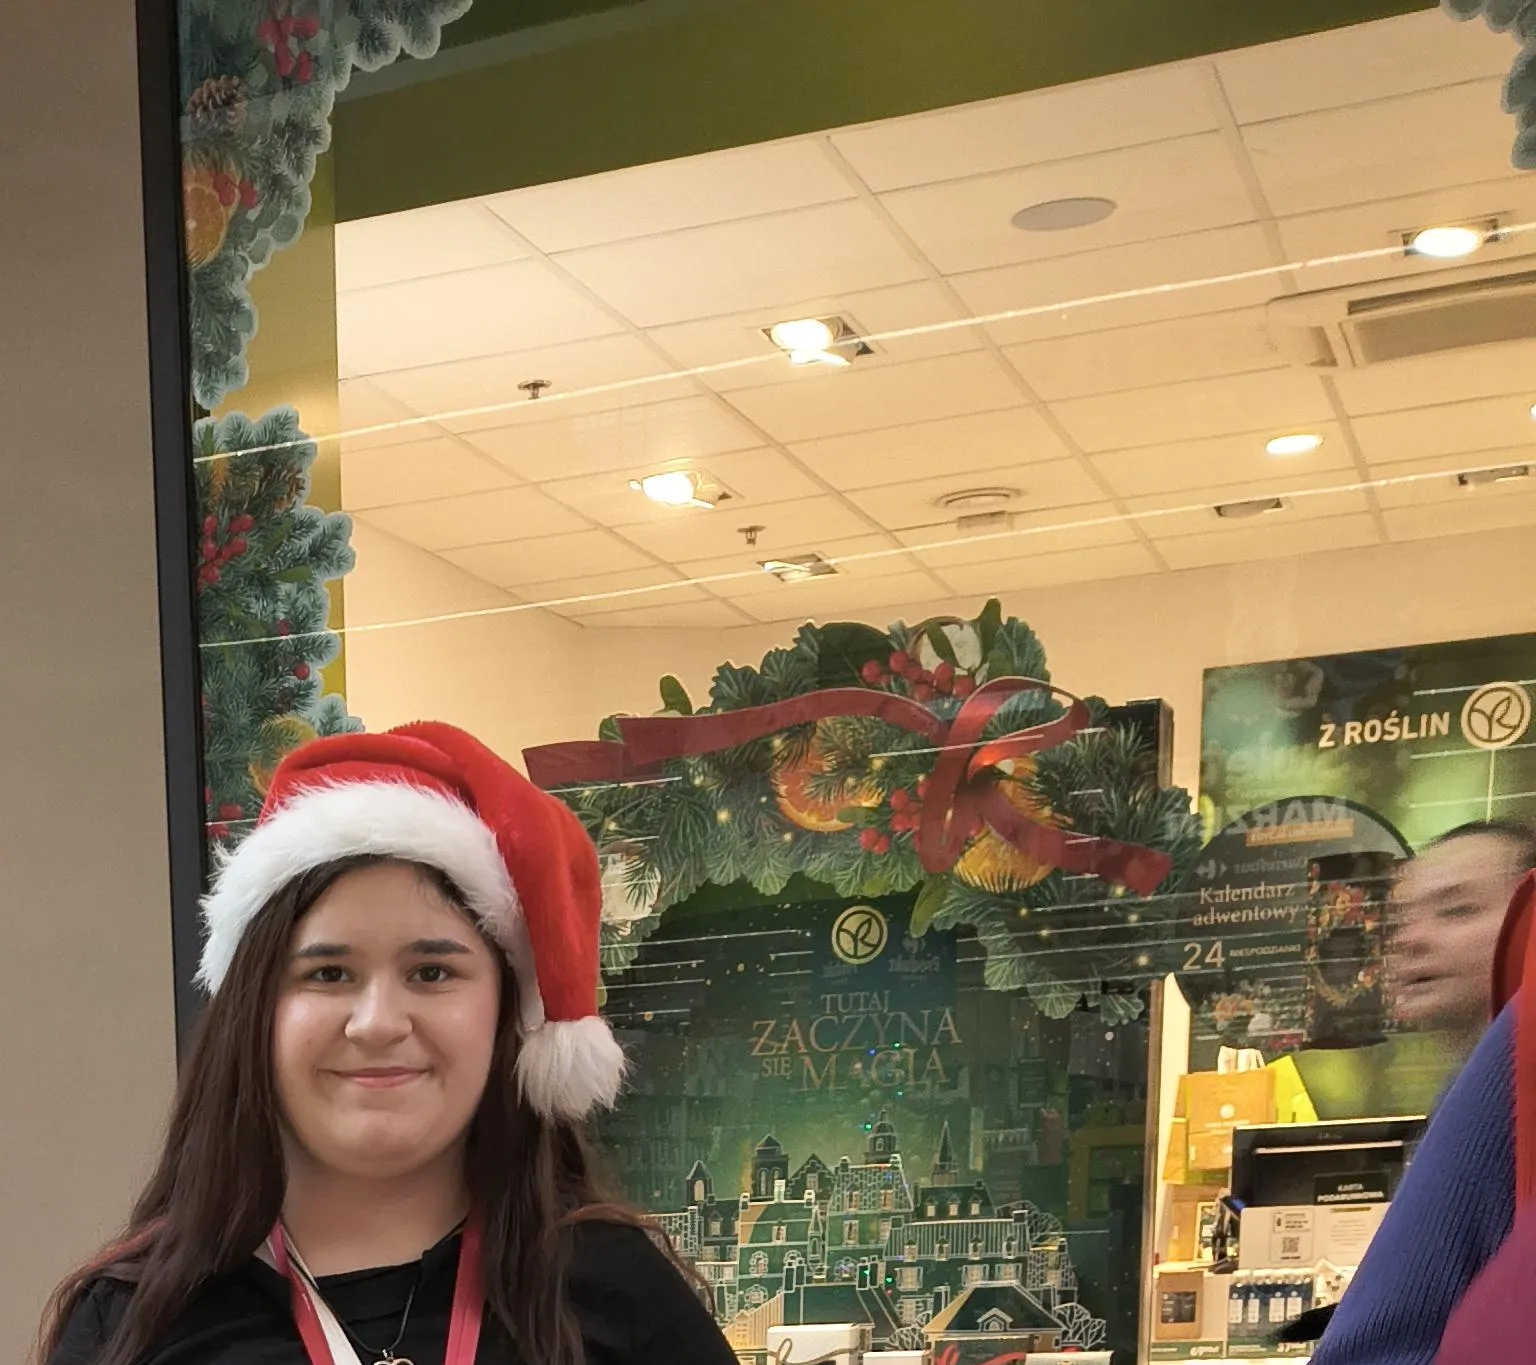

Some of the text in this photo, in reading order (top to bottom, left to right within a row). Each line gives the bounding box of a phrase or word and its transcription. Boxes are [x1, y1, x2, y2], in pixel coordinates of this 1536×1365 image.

[1318, 709, 1450, 749] Z ROŚLIN
[1199, 882, 1295, 905] Kalendarz
[1193, 904, 1299, 927] adwentowy
[1183, 940, 1225, 970] 24
[820, 990, 890, 1014] TUTAJ
[751, 1007, 963, 1056] ZACZYNA
[762, 1048, 951, 1092] SIĘ MAGIA
